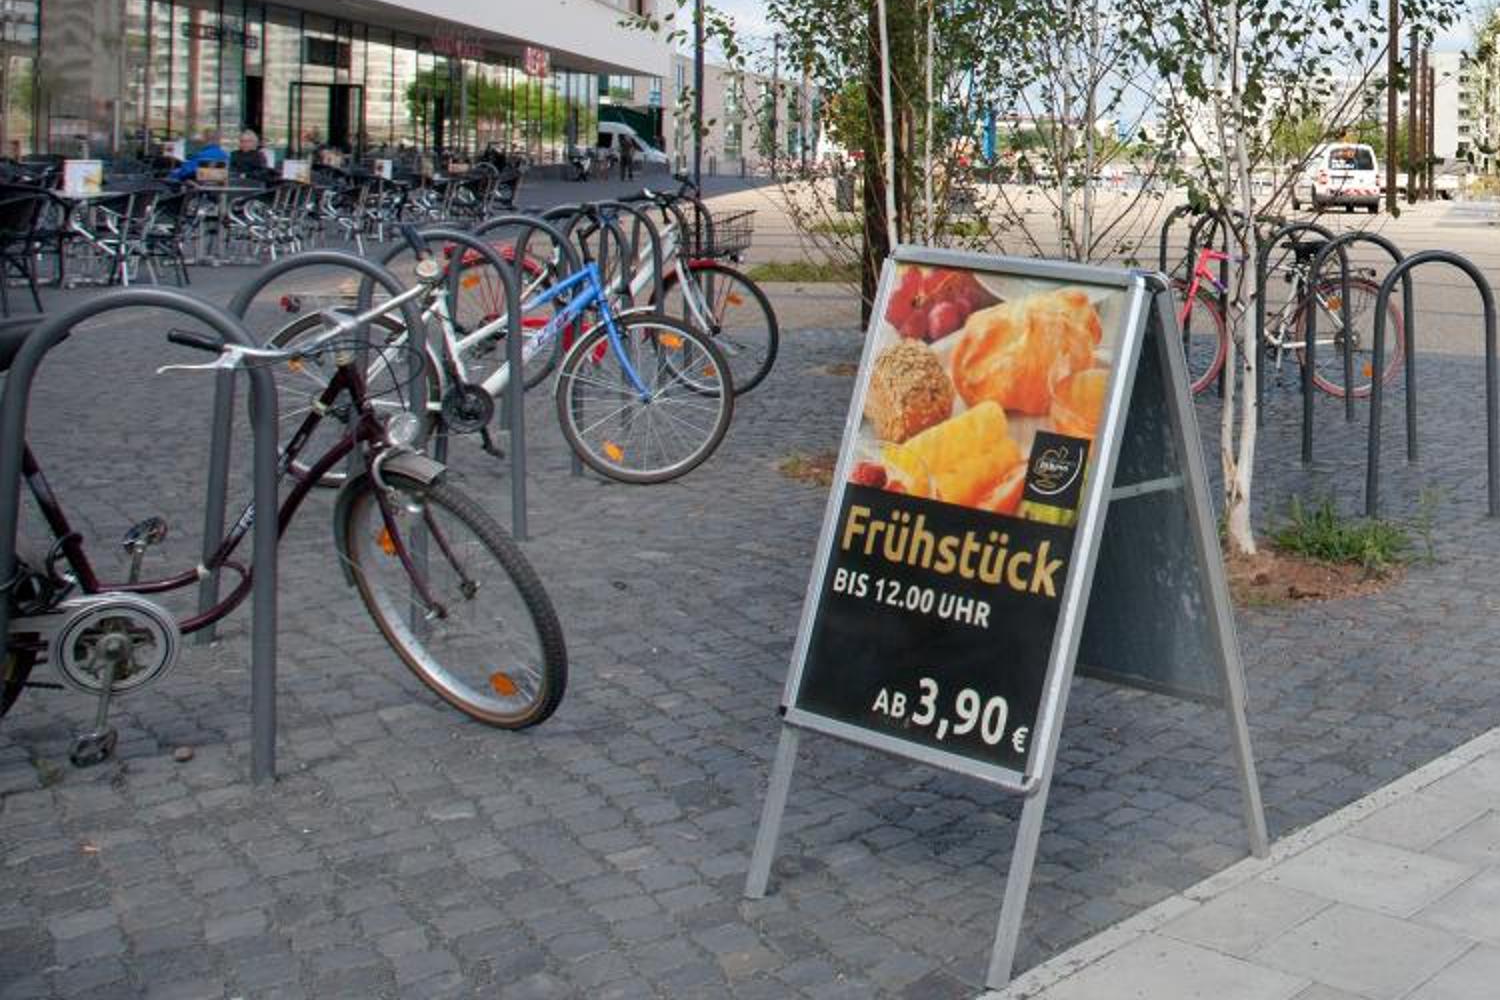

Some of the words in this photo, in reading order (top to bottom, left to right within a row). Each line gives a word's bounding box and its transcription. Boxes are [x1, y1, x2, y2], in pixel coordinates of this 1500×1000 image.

[841, 504, 1063, 598] Frühstück
[832, 567, 870, 598] BIS
[874, 578, 935, 614] 12.00
[937, 594, 992, 629] UHR
[872, 687, 907, 718] AB
[911, 677, 1009, 745] 3,90
[1011, 726, 1029, 753] €
